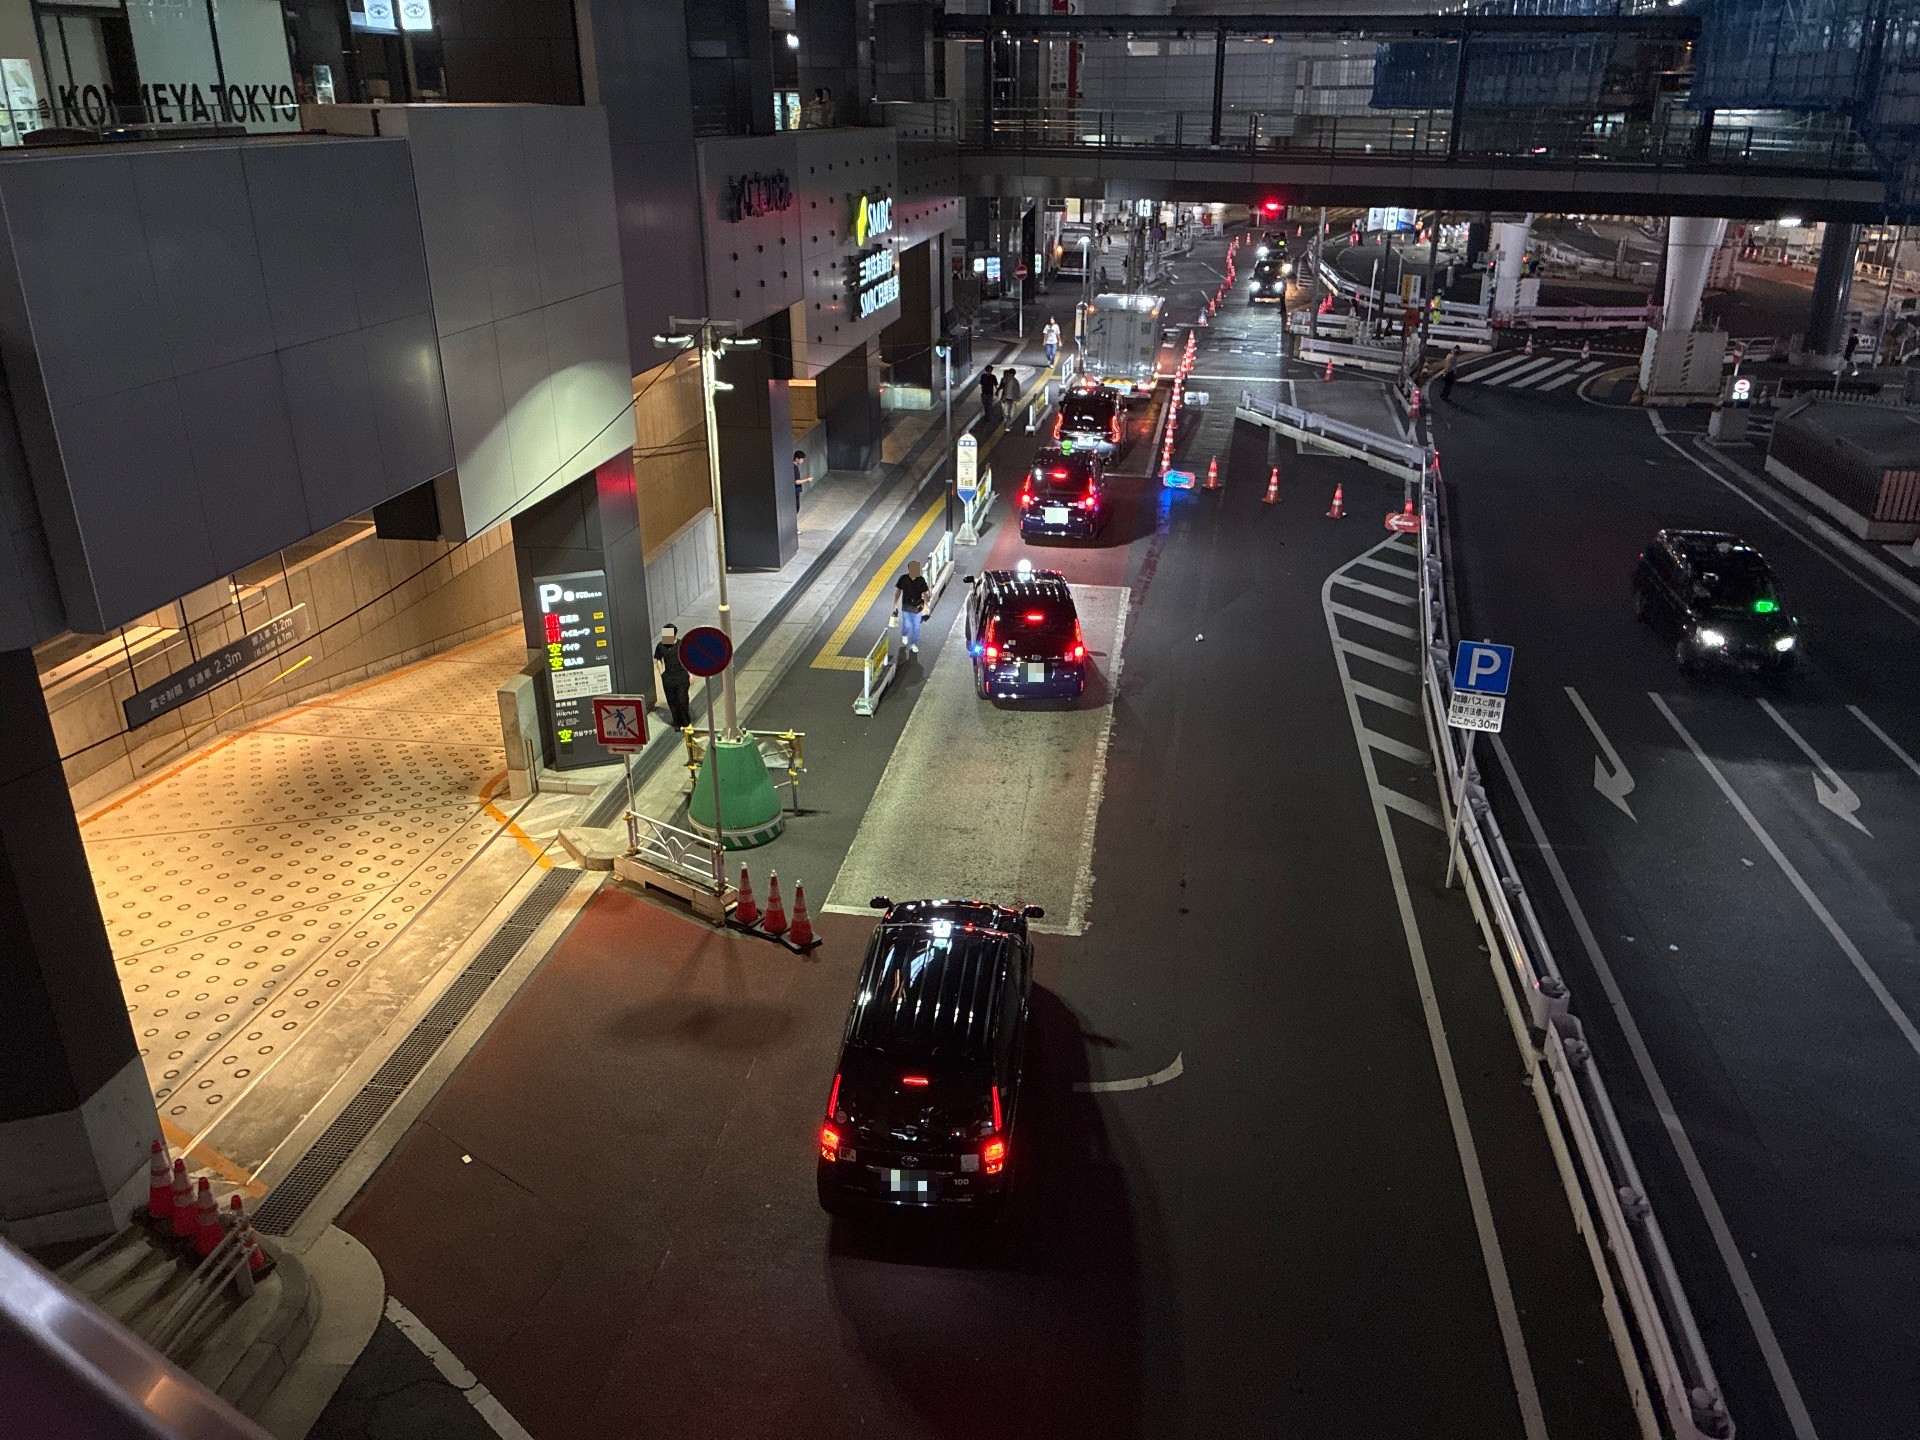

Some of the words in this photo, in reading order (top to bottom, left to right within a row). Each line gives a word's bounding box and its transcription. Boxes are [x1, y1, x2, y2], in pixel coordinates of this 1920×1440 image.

[211, 83, 297, 123] TOKYO
[868, 197, 893, 238] SMBC
[540, 583, 563, 613] P
[272, 618, 293, 634] 3.2m
[547, 643, 562, 656] 空
[214, 651, 242, 674] 2.3m
[549, 656, 564, 670] 空
[1468, 647, 1502, 687] P
[558, 729, 573, 743] 空
